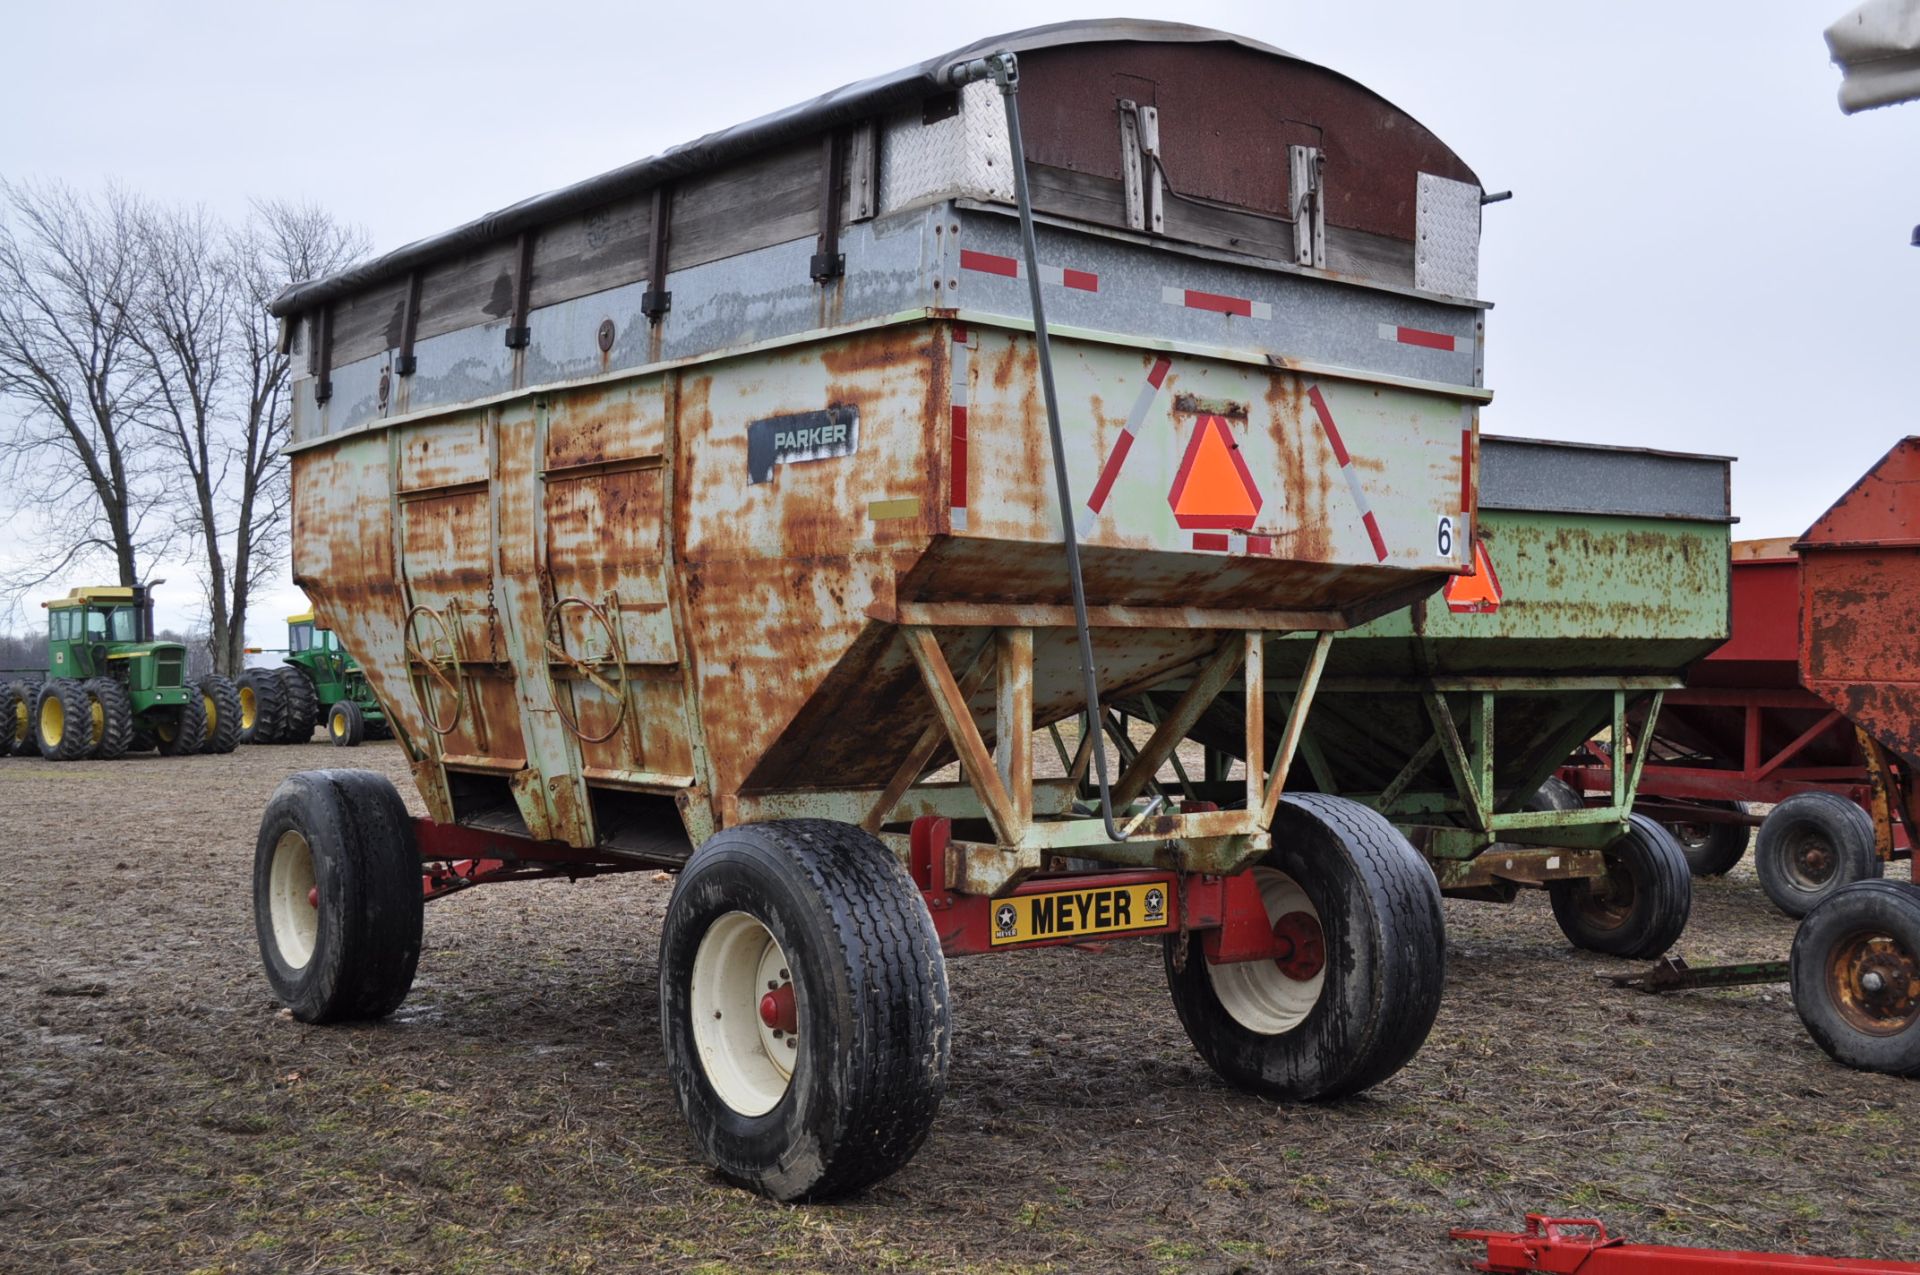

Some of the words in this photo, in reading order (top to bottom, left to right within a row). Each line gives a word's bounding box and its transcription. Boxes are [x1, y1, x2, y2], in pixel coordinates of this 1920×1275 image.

[775, 424, 846, 450] PARKER
[1438, 517, 1451, 556] 6
[1031, 890, 1131, 935] MEYER
